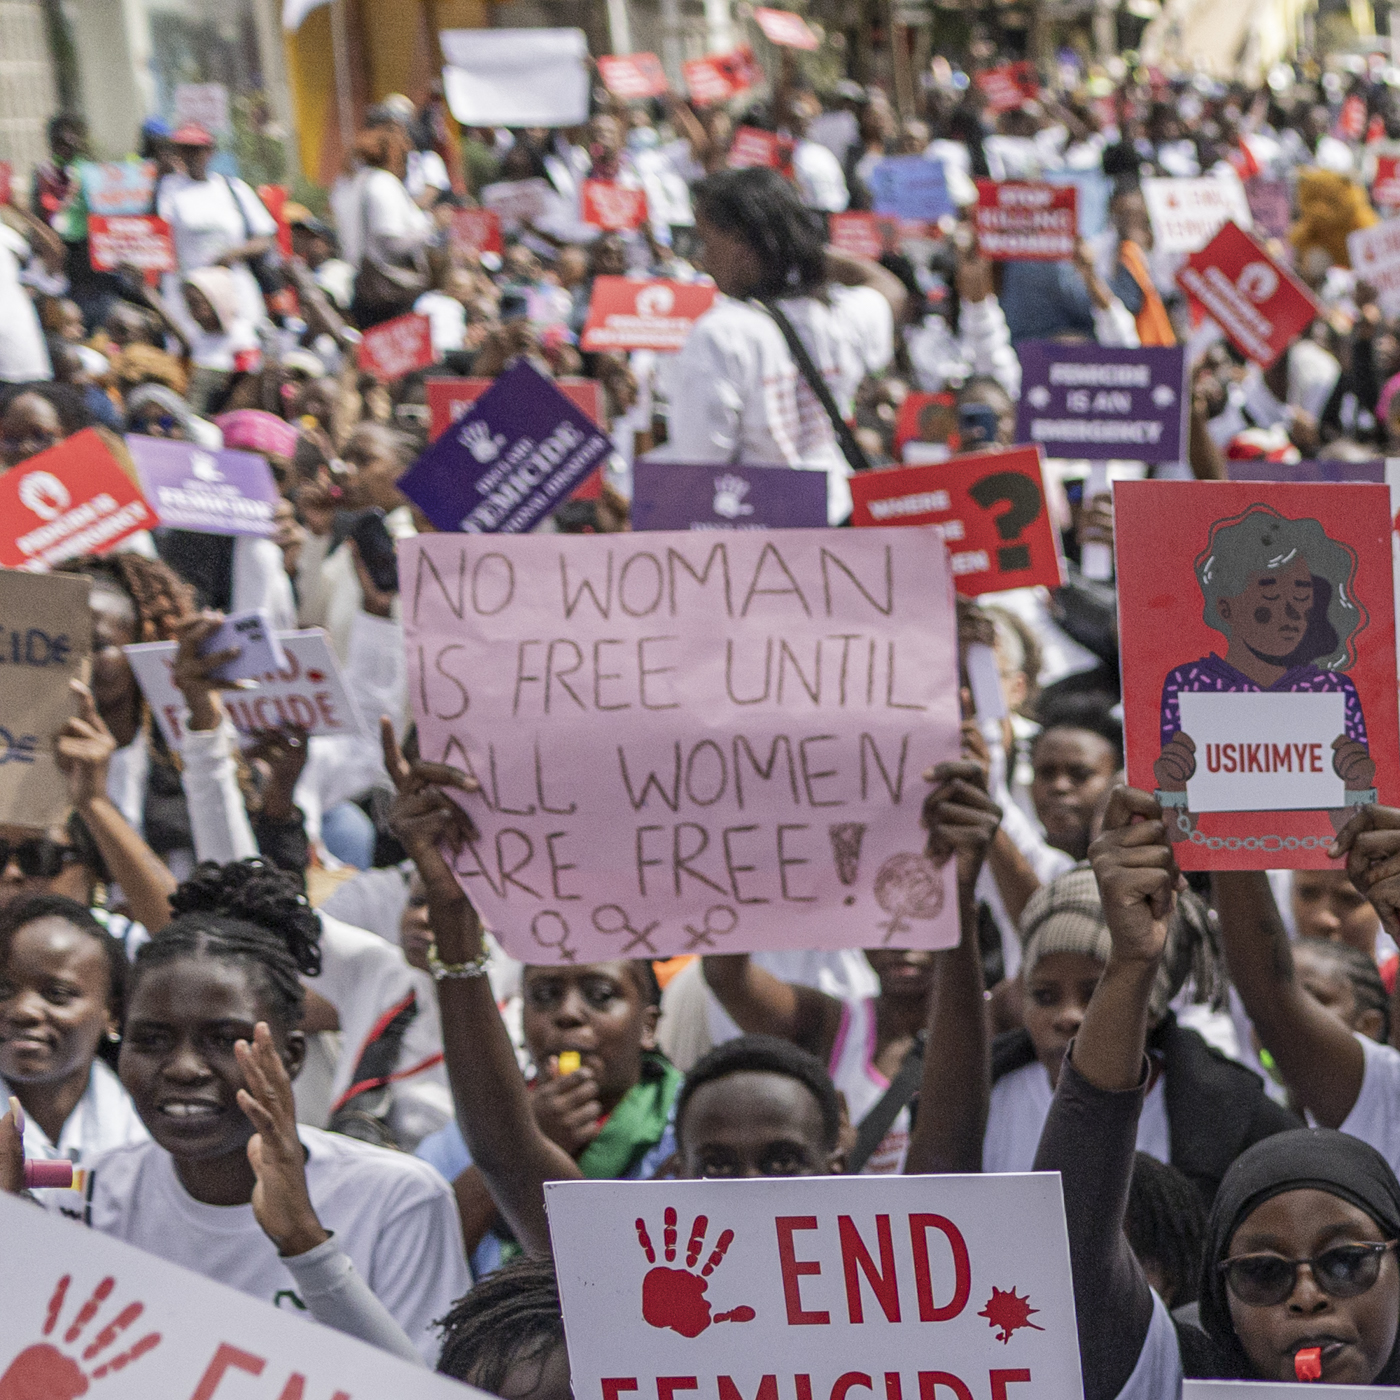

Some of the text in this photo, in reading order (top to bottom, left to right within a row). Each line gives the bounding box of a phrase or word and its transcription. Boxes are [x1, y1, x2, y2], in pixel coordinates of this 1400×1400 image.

[867, 489, 950, 521] WHERE
[412, 545, 516, 620] NO
[560, 541, 894, 620] WOMAN
[415, 633, 928, 721] IS FREE UNTIL
[617, 732, 912, 813] WOMEN
[1205, 741, 1324, 774] USIKIMYE
[453, 826, 582, 901] ARE
[774, 1211, 974, 1326] END
